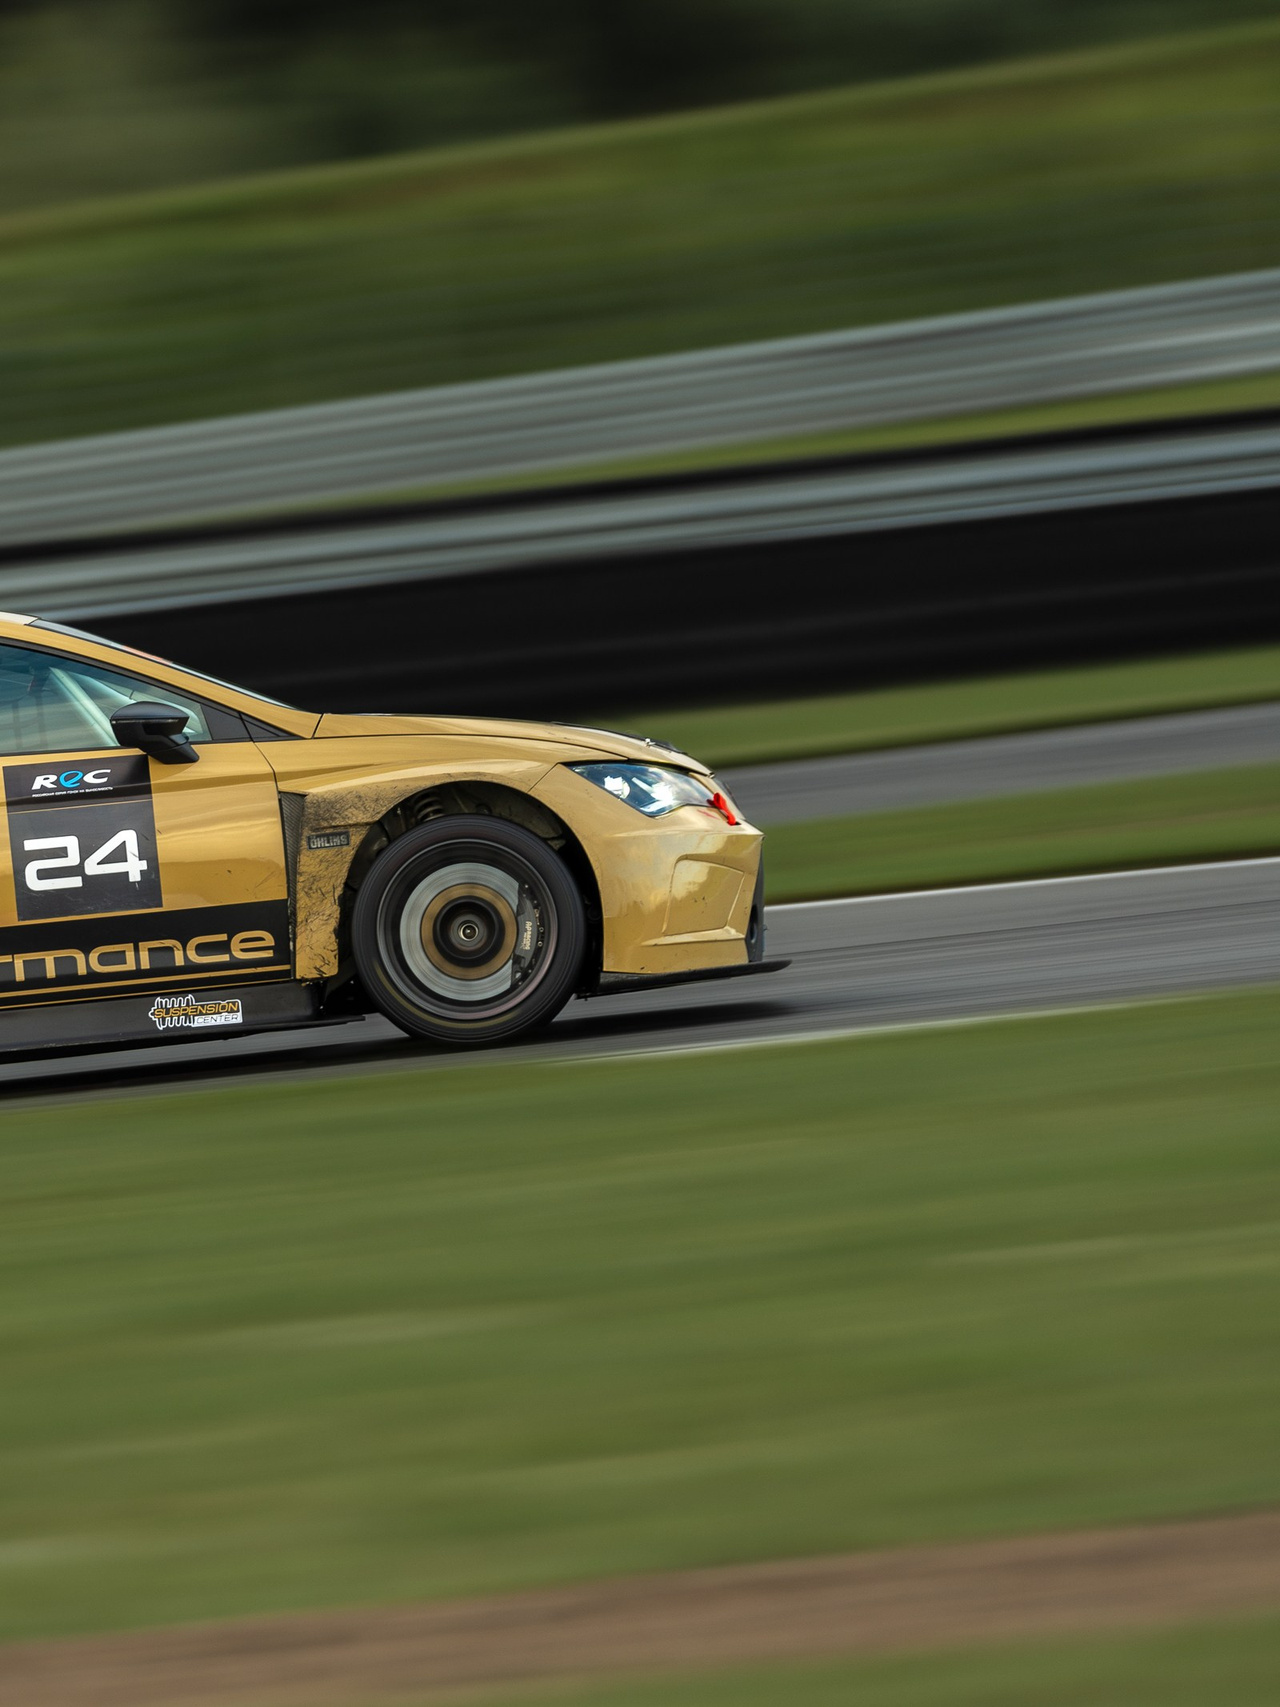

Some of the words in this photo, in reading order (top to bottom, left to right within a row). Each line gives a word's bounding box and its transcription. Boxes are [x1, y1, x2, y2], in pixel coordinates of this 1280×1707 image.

[23, 829, 148, 891] 24
[154, 1002, 239, 1018] SUSPENSION
[196, 1013, 239, 1024] CENTER
